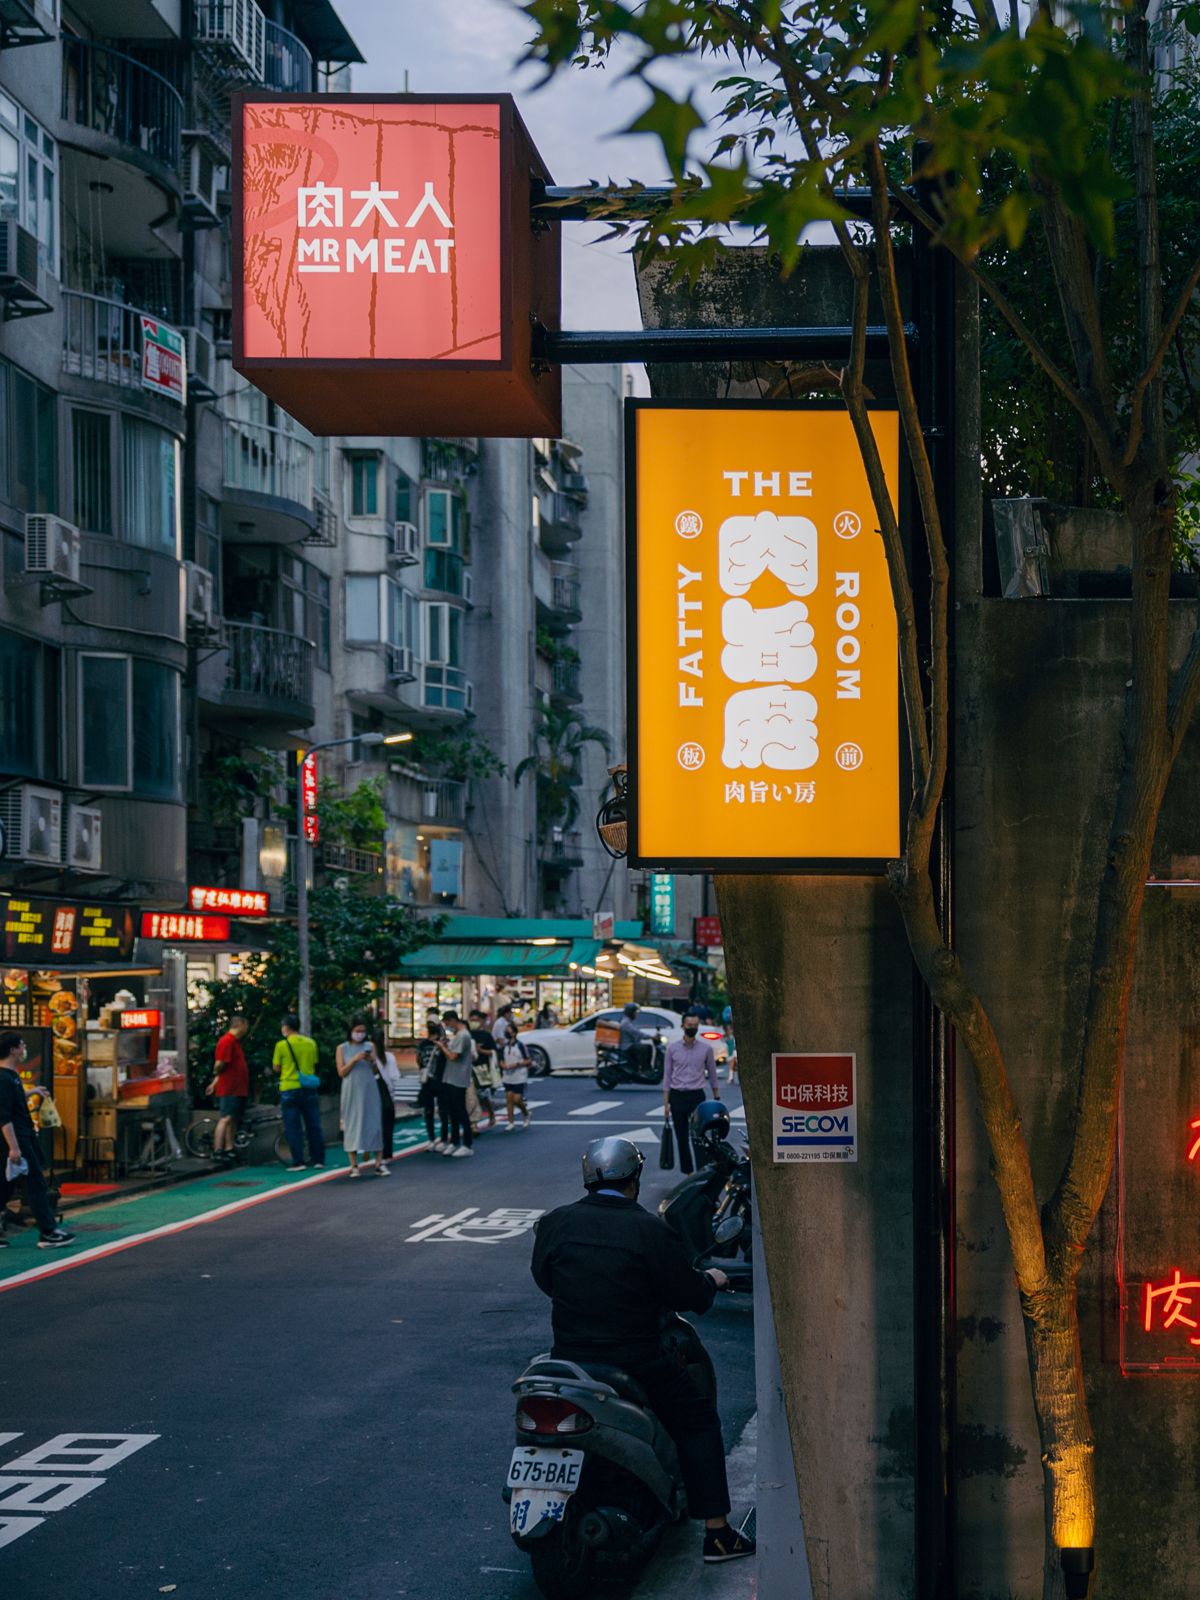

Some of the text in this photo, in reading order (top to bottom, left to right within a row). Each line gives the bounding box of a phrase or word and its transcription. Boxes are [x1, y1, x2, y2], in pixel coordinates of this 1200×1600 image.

[298, 181, 454, 228] 肉大人
[298, 238, 455, 273] MR MEAT
[723, 471, 812, 497] THE
[836, 513, 858, 536] 火
[677, 563, 704, 707] FATTY
[835, 571, 861, 700] ROOM
[681, 745, 703, 767] 板
[838, 745, 860, 767] 前
[724, 781, 816, 803] 肉旨い房
[781, 1084, 848, 1103] 中保科技
[782, 1115, 848, 1133] SECOM
[404, 1207, 546, 1244] 慢
